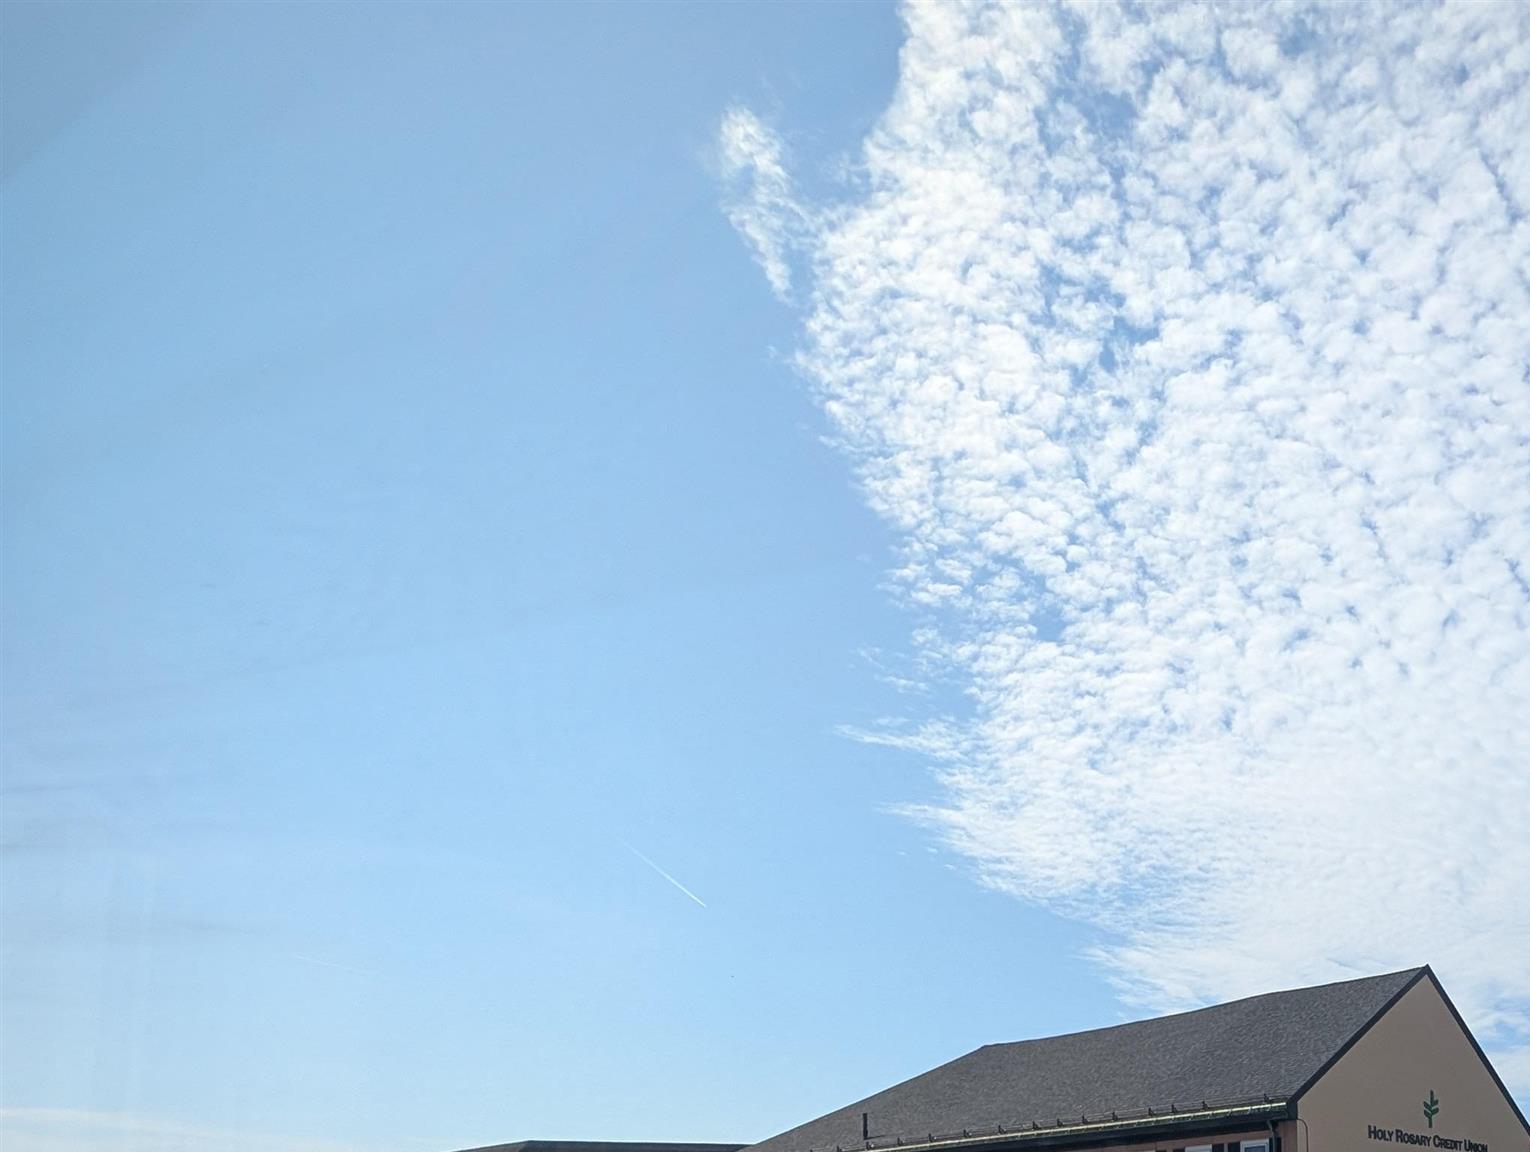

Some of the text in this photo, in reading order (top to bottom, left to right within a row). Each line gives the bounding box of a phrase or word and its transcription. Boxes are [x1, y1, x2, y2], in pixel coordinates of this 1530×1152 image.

[1367, 1125, 1394, 1142] HOLY
[1395, 1129, 1432, 1147] ROSARY
[1433, 1135, 1463, 1151] CREDIT
